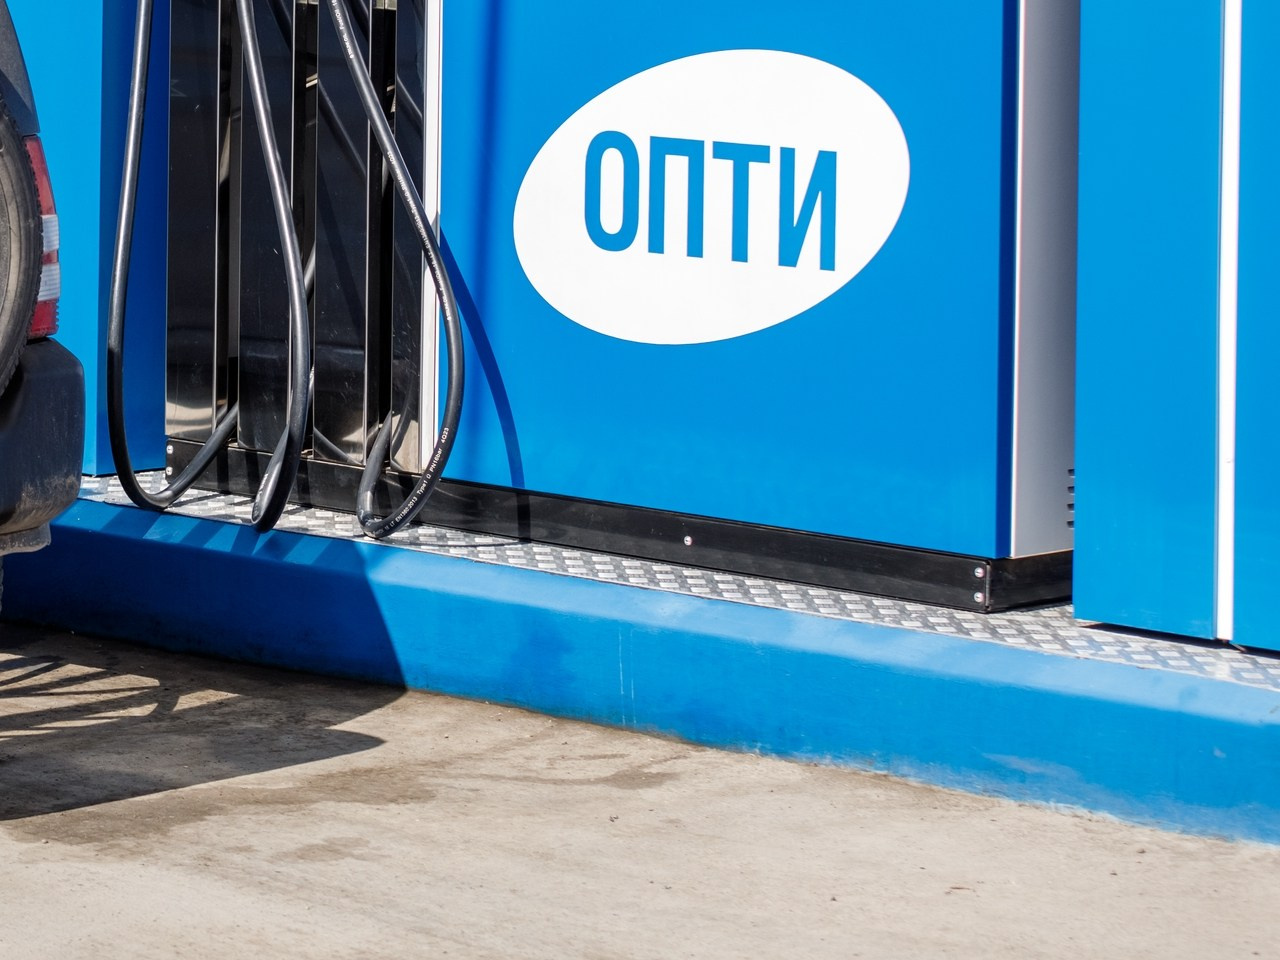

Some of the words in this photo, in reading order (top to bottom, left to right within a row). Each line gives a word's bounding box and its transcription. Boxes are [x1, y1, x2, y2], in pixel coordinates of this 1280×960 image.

[584, 130, 837, 271] ОПТИ
[416, 480, 428, 495] Type1
[429, 448, 443, 473] PN16bar
[441, 427, 449, 443] 4Q23
